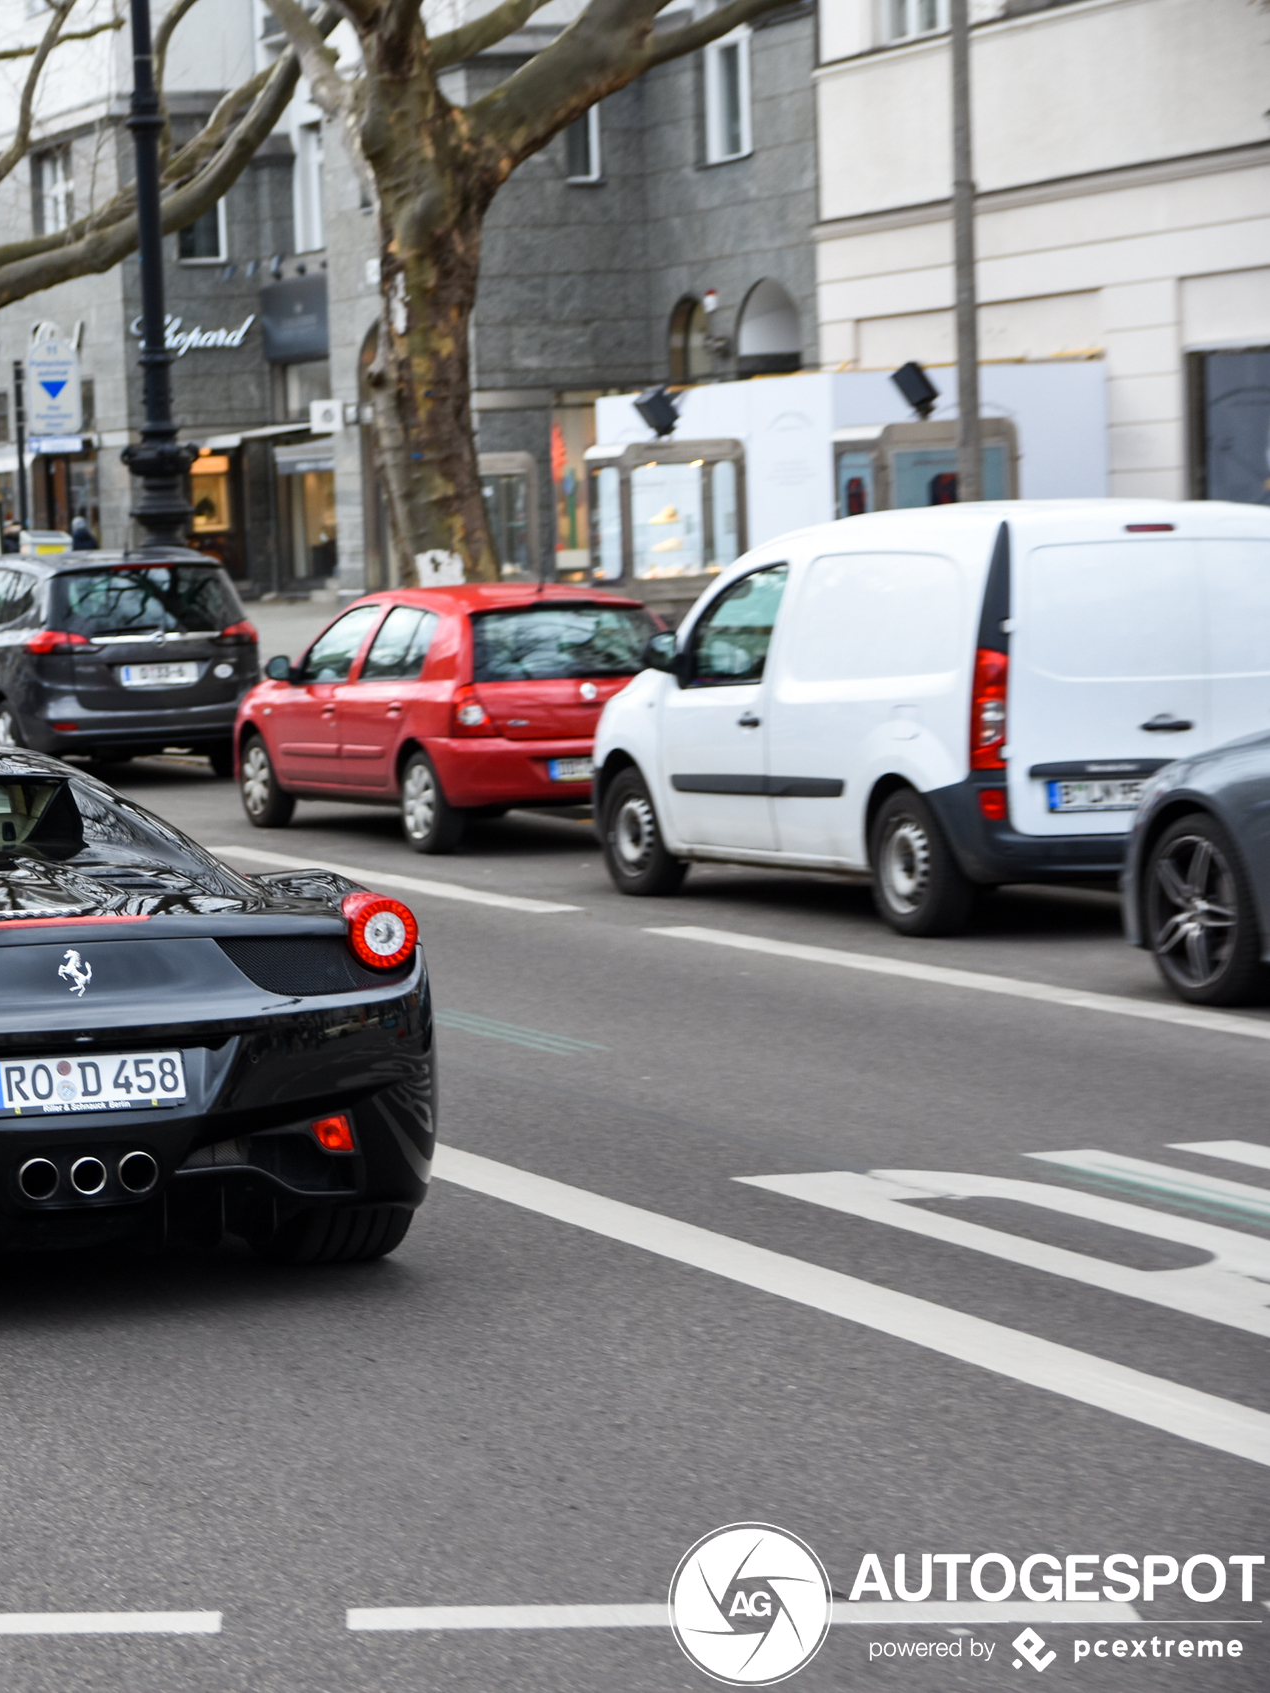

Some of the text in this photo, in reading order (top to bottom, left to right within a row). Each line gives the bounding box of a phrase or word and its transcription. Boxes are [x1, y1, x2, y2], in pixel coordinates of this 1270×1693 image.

[5, 1058, 179, 1101] RO D 458
[108, 1100, 132, 1109] Berlin
